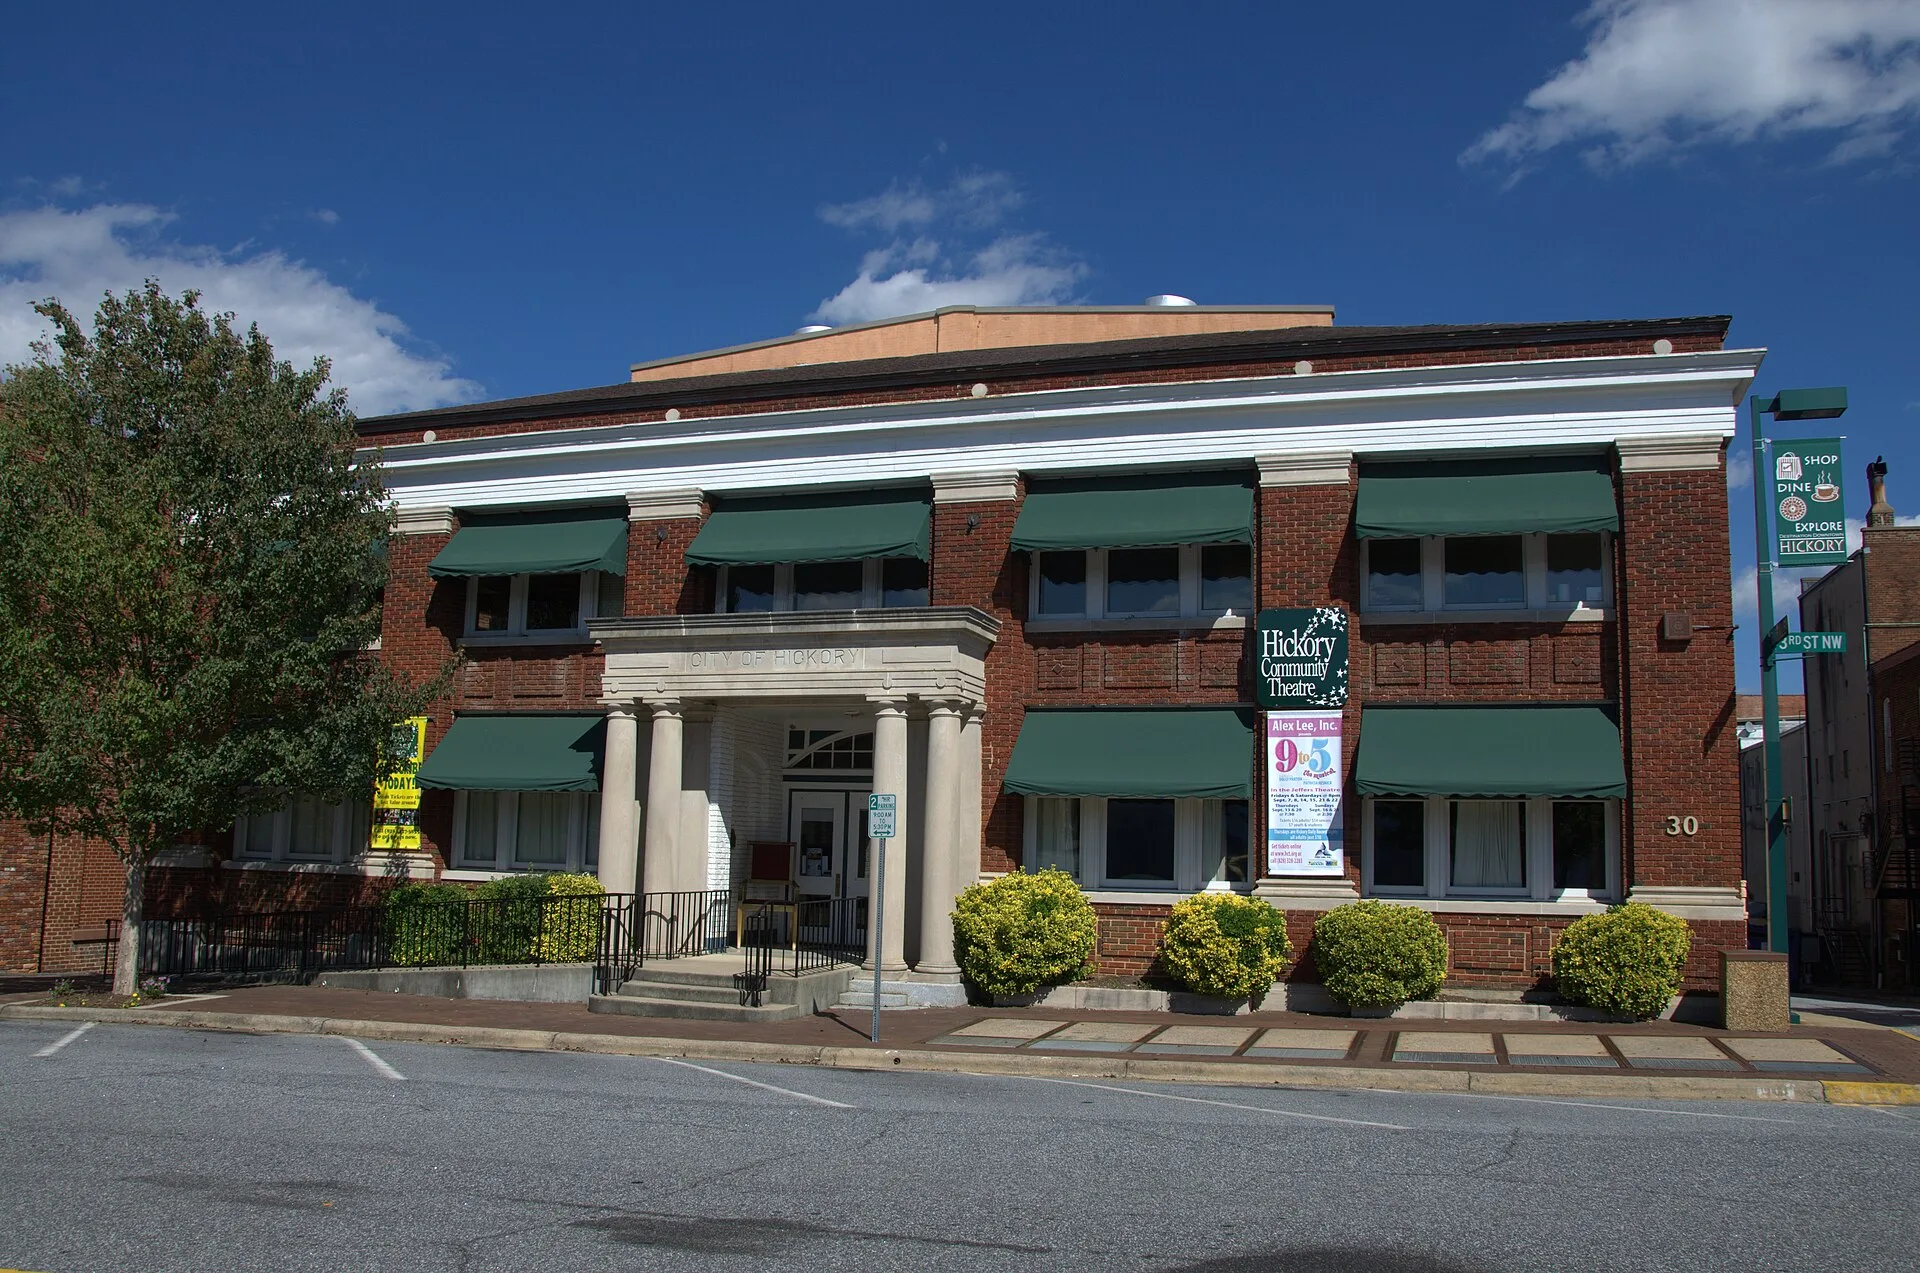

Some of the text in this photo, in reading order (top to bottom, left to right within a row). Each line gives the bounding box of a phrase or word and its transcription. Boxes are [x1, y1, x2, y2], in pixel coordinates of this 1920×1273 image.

[1804, 455, 1838, 466] SHOP
[1777, 482, 1811, 493] DINE
[1795, 521, 1843, 532] EXPLORE
[1780, 539, 1844, 552] HICKORY
[1261, 628, 1337, 662] Hickory
[1779, 635, 1843, 649] 3RD ST NW
[690, 648, 859, 667] CITY OF HICKORY
[1261, 657, 1329, 681] Community
[1266, 677, 1316, 697] Theatre
[1272, 719, 1338, 732] Alex Lee, Inc.
[1275, 738, 1331, 773] 9 to 5
[870, 797, 877, 808] 2
[1666, 815, 1699, 835] 30
